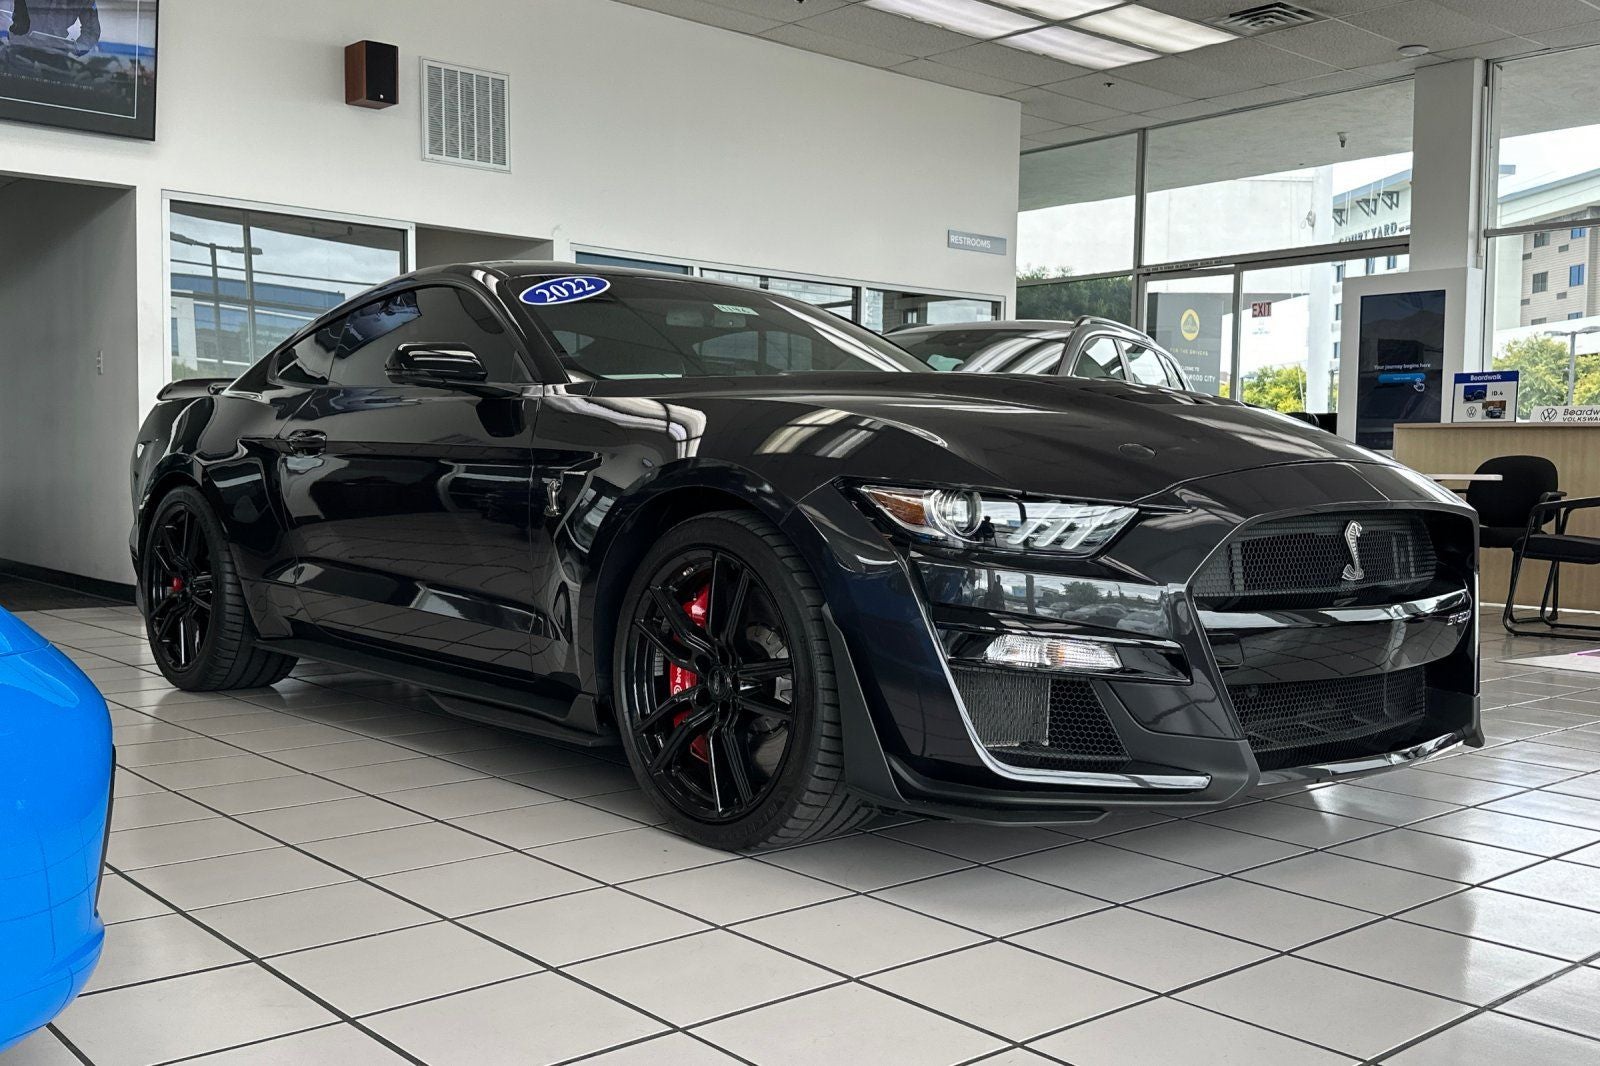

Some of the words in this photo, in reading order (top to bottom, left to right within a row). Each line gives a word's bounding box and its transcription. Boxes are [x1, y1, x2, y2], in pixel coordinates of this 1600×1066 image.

[950, 234, 991, 249] RESTROOMS
[535, 278, 596, 303] 2022
[1252, 302, 1272, 318] EXIT
[1403, 362, 1419, 370] begins
[1204, 375, 1216, 383] CITY
